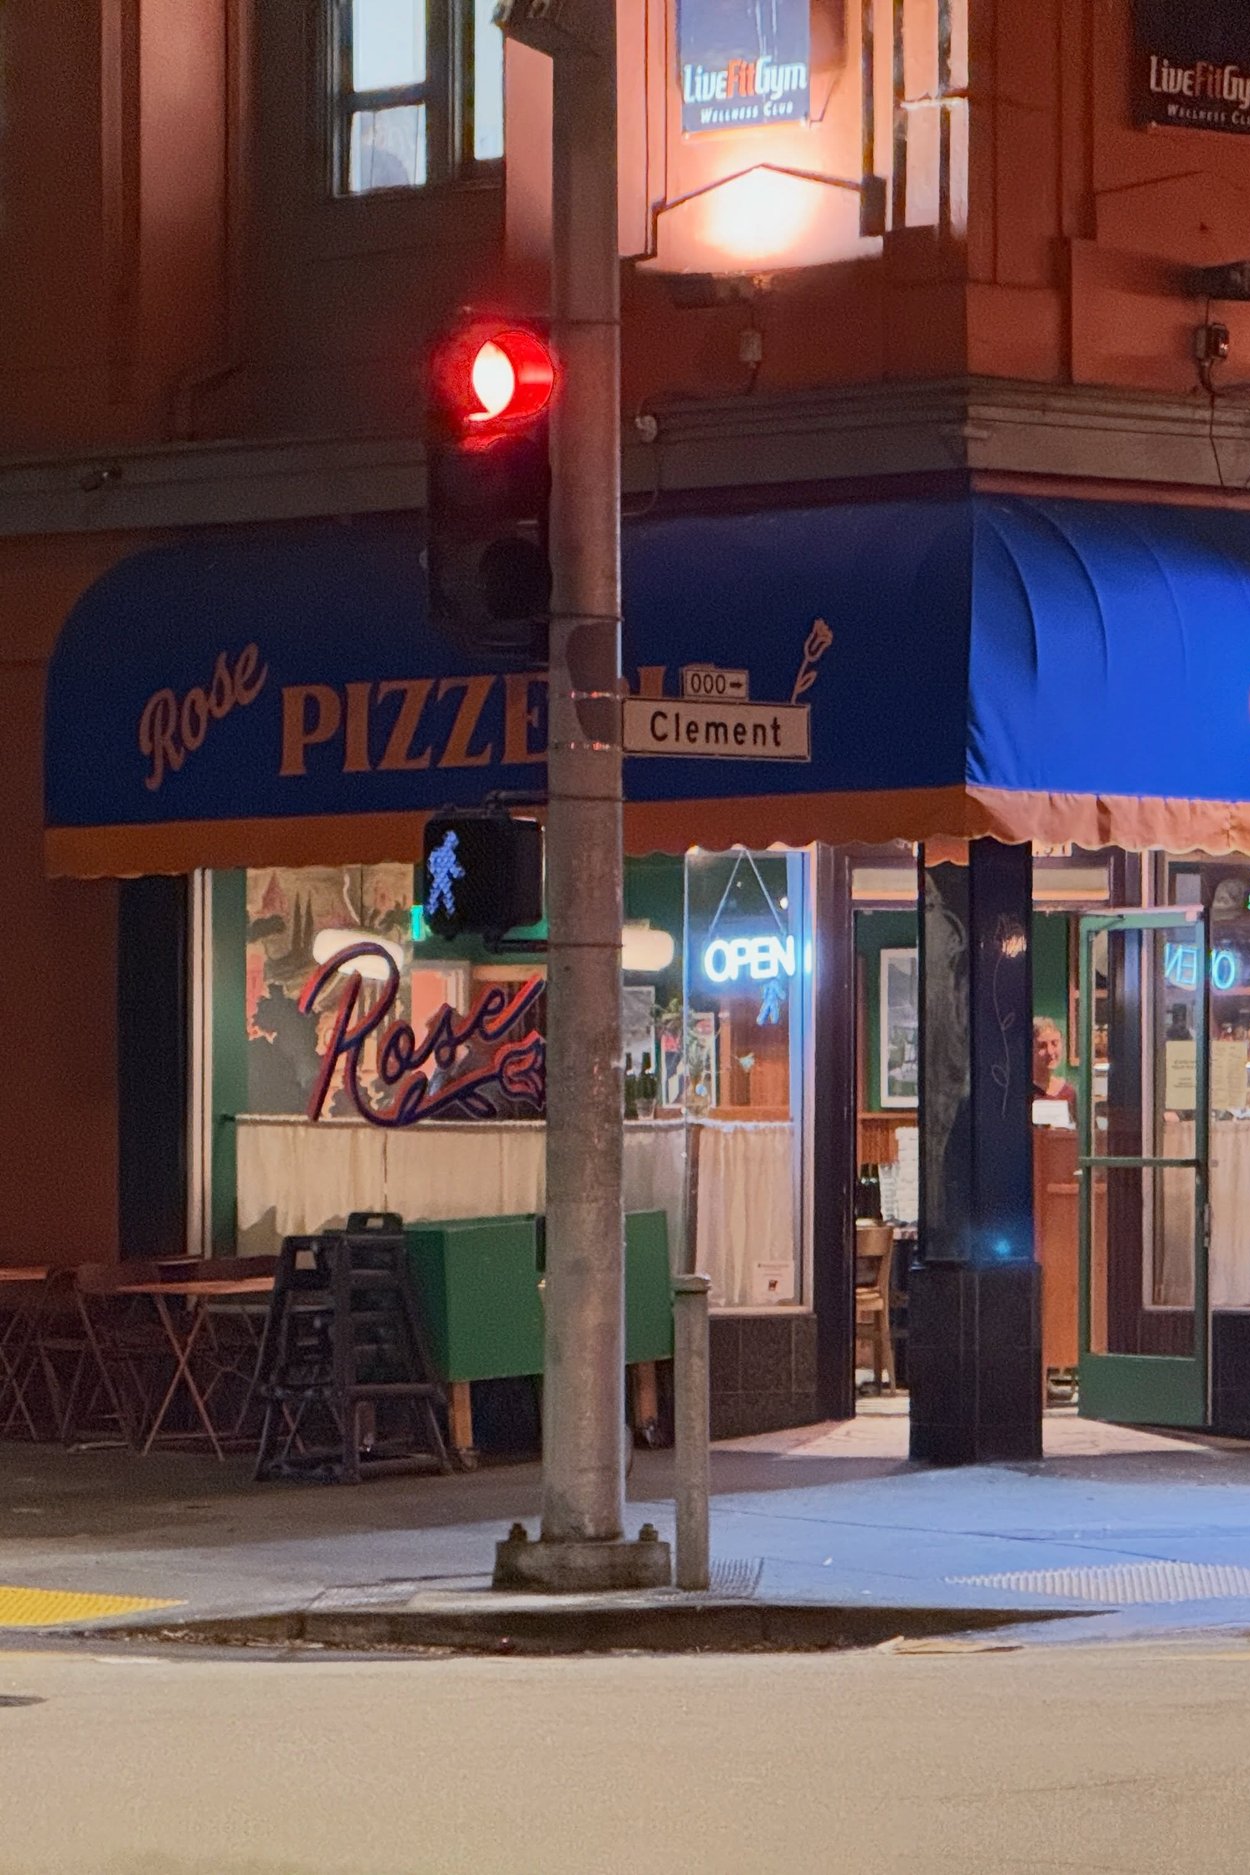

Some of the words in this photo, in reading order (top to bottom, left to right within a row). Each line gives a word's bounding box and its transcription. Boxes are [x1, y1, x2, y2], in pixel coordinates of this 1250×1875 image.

[138, 642, 268, 791] Rose
[279, 664, 714, 777] PIZZE
[650, 710, 782, 749] Clement
[704, 935, 796, 983] OPEN
[298, 941, 546, 1128] Rose
